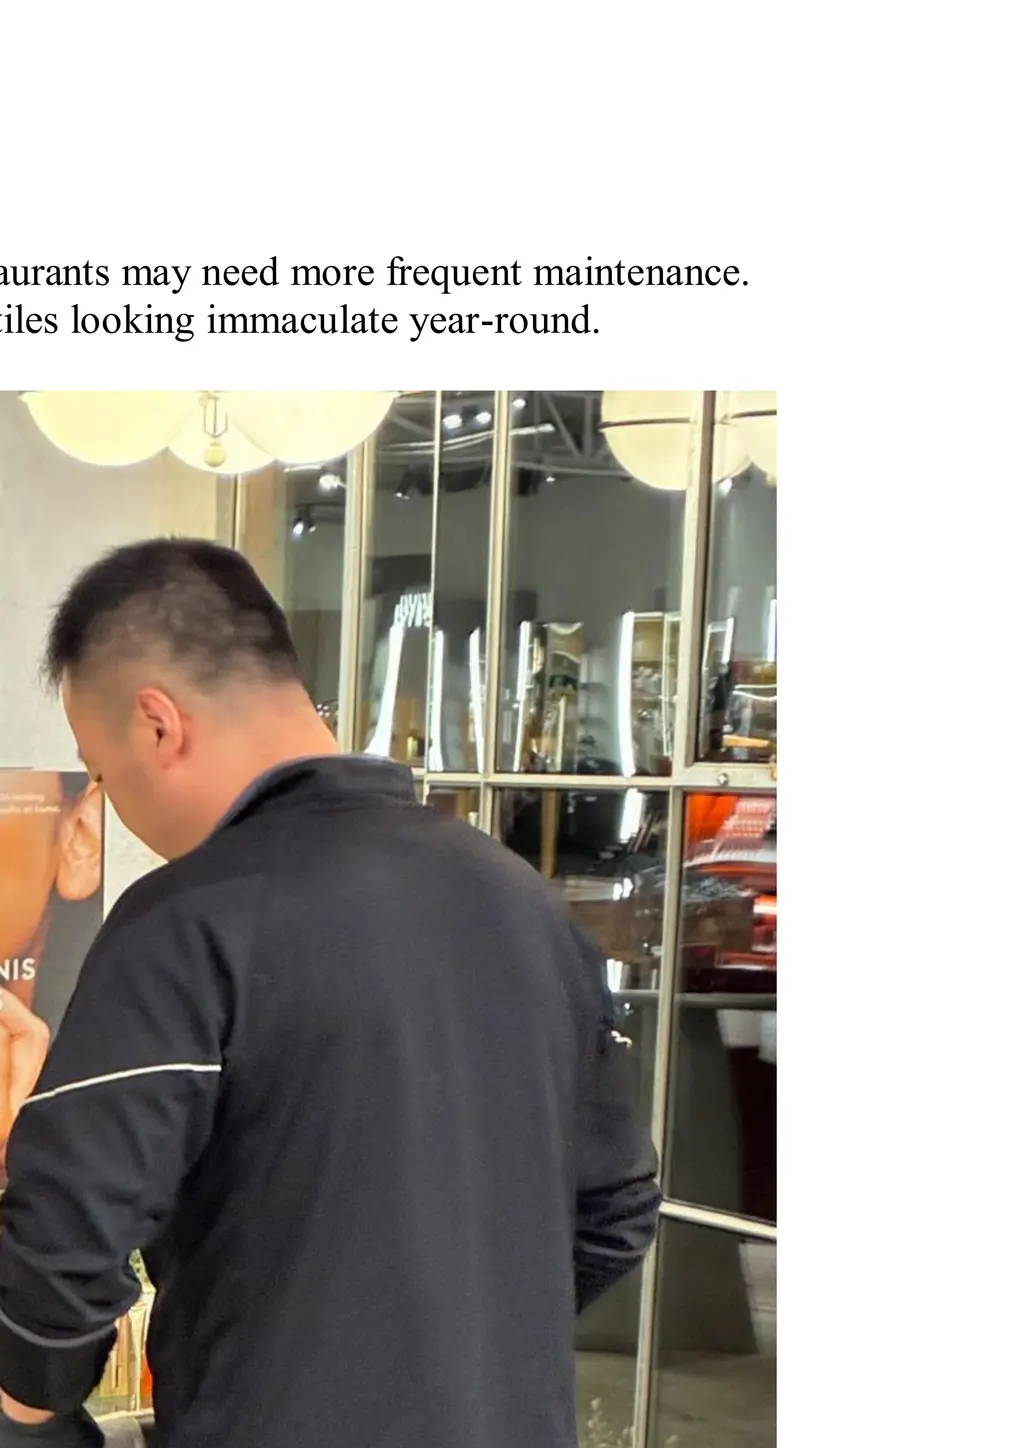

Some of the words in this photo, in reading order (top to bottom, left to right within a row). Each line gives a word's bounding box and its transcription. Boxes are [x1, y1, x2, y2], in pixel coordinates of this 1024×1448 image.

[122, 266, 191, 294] may
[202, 256, 279, 286] need
[291, 266, 374, 286] more
[387, 256, 521, 294] frequent
[534, 256, 748, 286] maintenance.
[72, 304, 194, 342] looking
[208, 304, 397, 334] immaculate
[409, 304, 598, 342] year-round.
